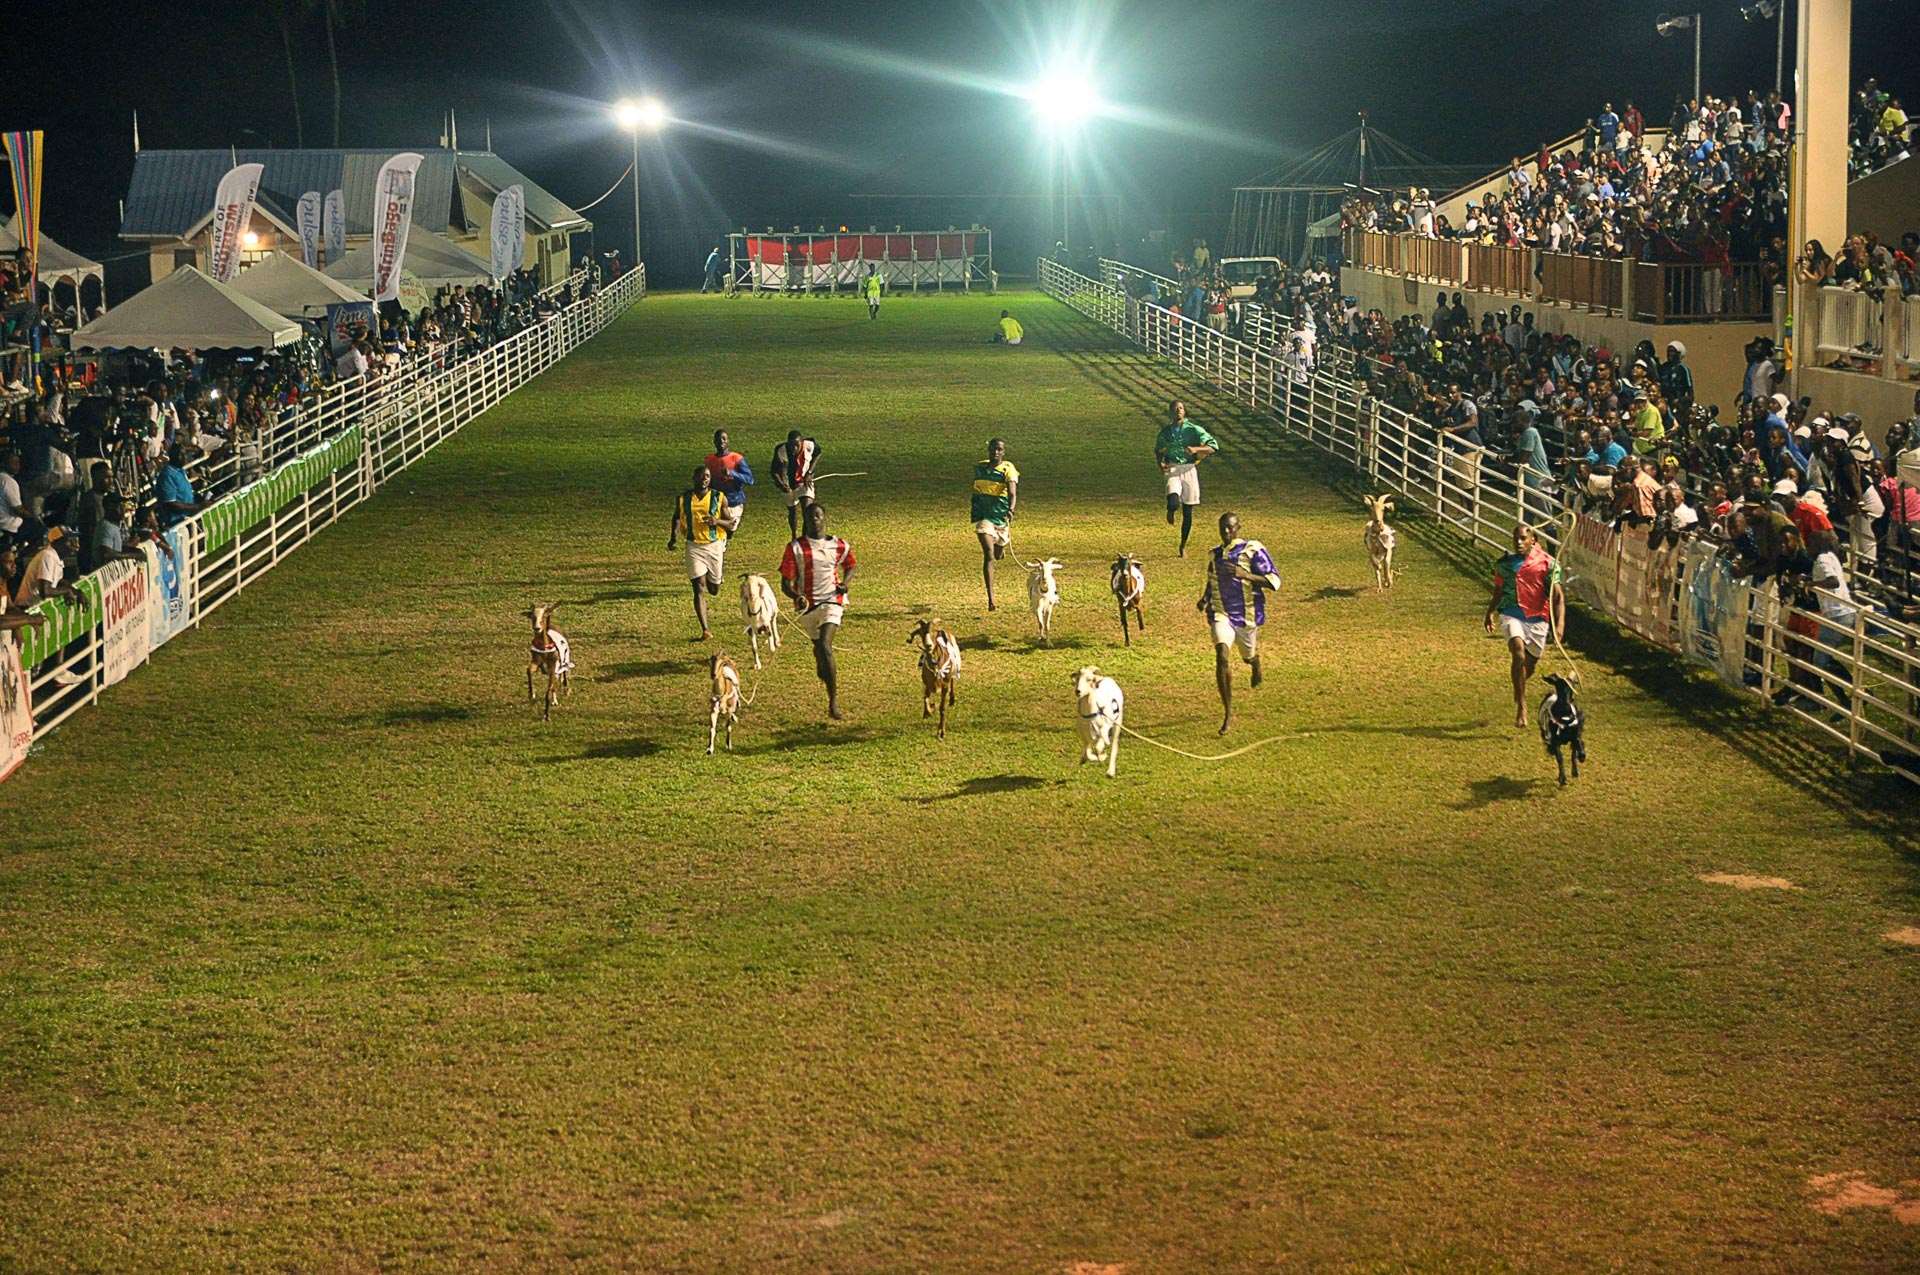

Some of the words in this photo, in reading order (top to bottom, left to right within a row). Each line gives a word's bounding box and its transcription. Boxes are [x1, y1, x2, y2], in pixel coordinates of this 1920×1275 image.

[217, 205, 225, 221] OF
[301, 198, 318, 248] pulse
[217, 204, 238, 284] OURISM
[334, 306, 370, 323] lime
[105, 568, 145, 630] TOURISM
